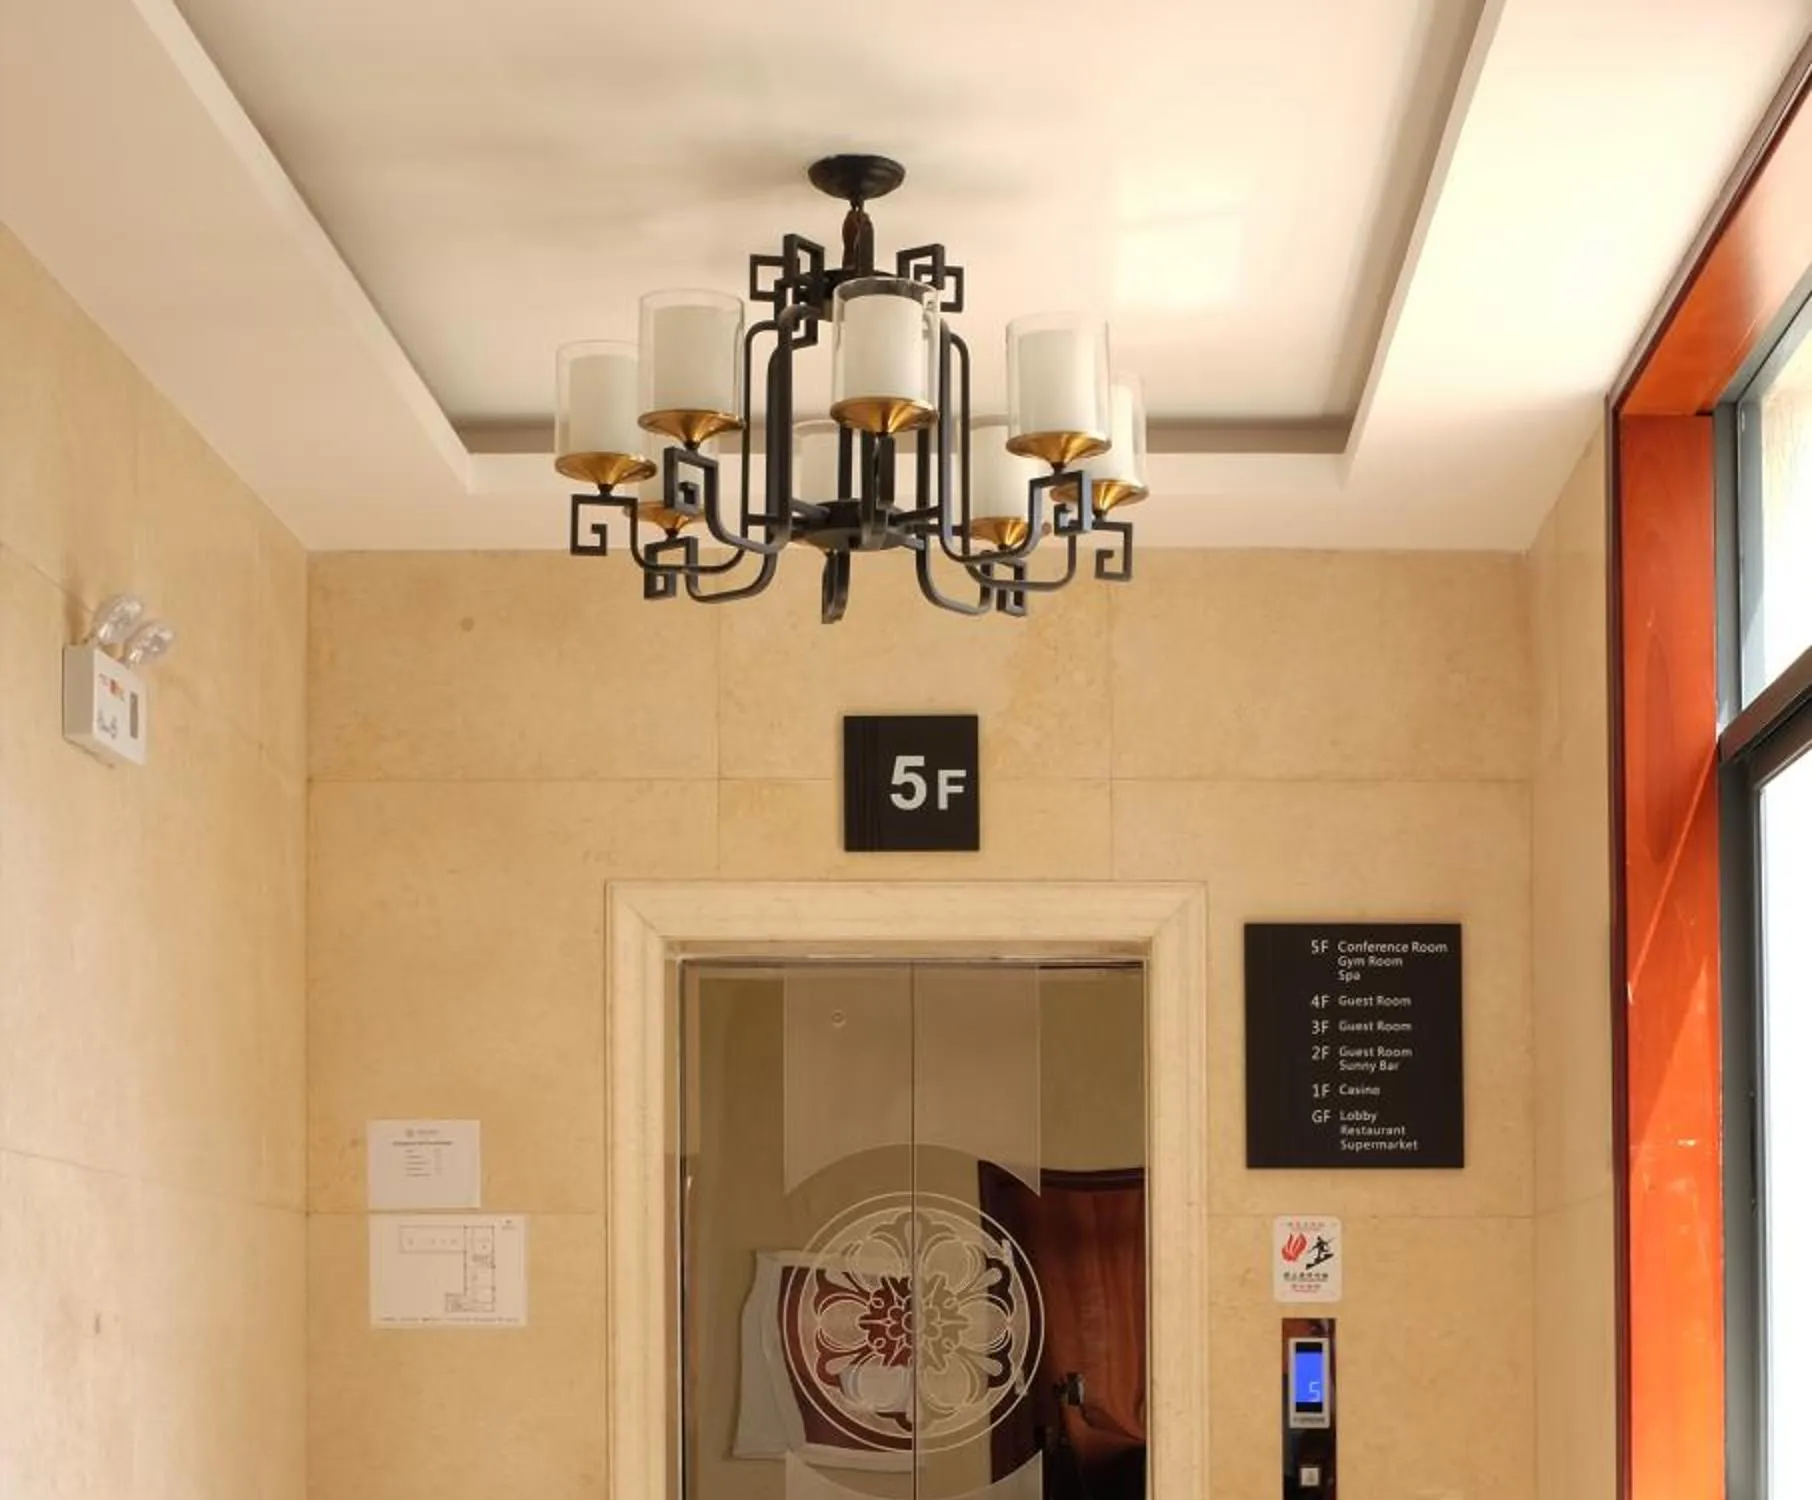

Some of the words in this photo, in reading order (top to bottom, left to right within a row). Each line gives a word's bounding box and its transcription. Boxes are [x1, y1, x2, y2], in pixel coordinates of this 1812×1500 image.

[890, 755, 967, 811] 5F
[1311, 940, 1329, 955] 5F
[1337, 940, 1409, 954] Conference
[1411, 942, 1448, 953] Room
[1337, 956, 1366, 970] Gym
[1367, 956, 1403, 967] Room
[1337, 970, 1361, 983] Spa
[1310, 995, 1331, 1009] 4F
[1337, 996, 1374, 1007] Guest
[1375, 996, 1412, 1007] Room
[1311, 1020, 1329, 1035] 3F
[1338, 1021, 1374, 1032] Guest
[1376, 1021, 1412, 1032] Room
[1311, 1046, 1330, 1061] 2F
[1338, 1046, 1375, 1058] Guest
[1377, 1046, 1413, 1058] Room
[1338, 1059, 1377, 1074] Sunny
[1378, 1060, 1399, 1072] Bar
[1312, 1084, 1331, 1099] 1F
[1338, 1084, 1381, 1096] Casino
[1311, 1109, 1331, 1124] GF
[1339, 1110, 1377, 1124] Lobby
[1340, 1125, 1406, 1137] Restaurant
[1340, 1139, 1418, 1153] Supermarket
[1308, 1381, 1321, 1403] 5
